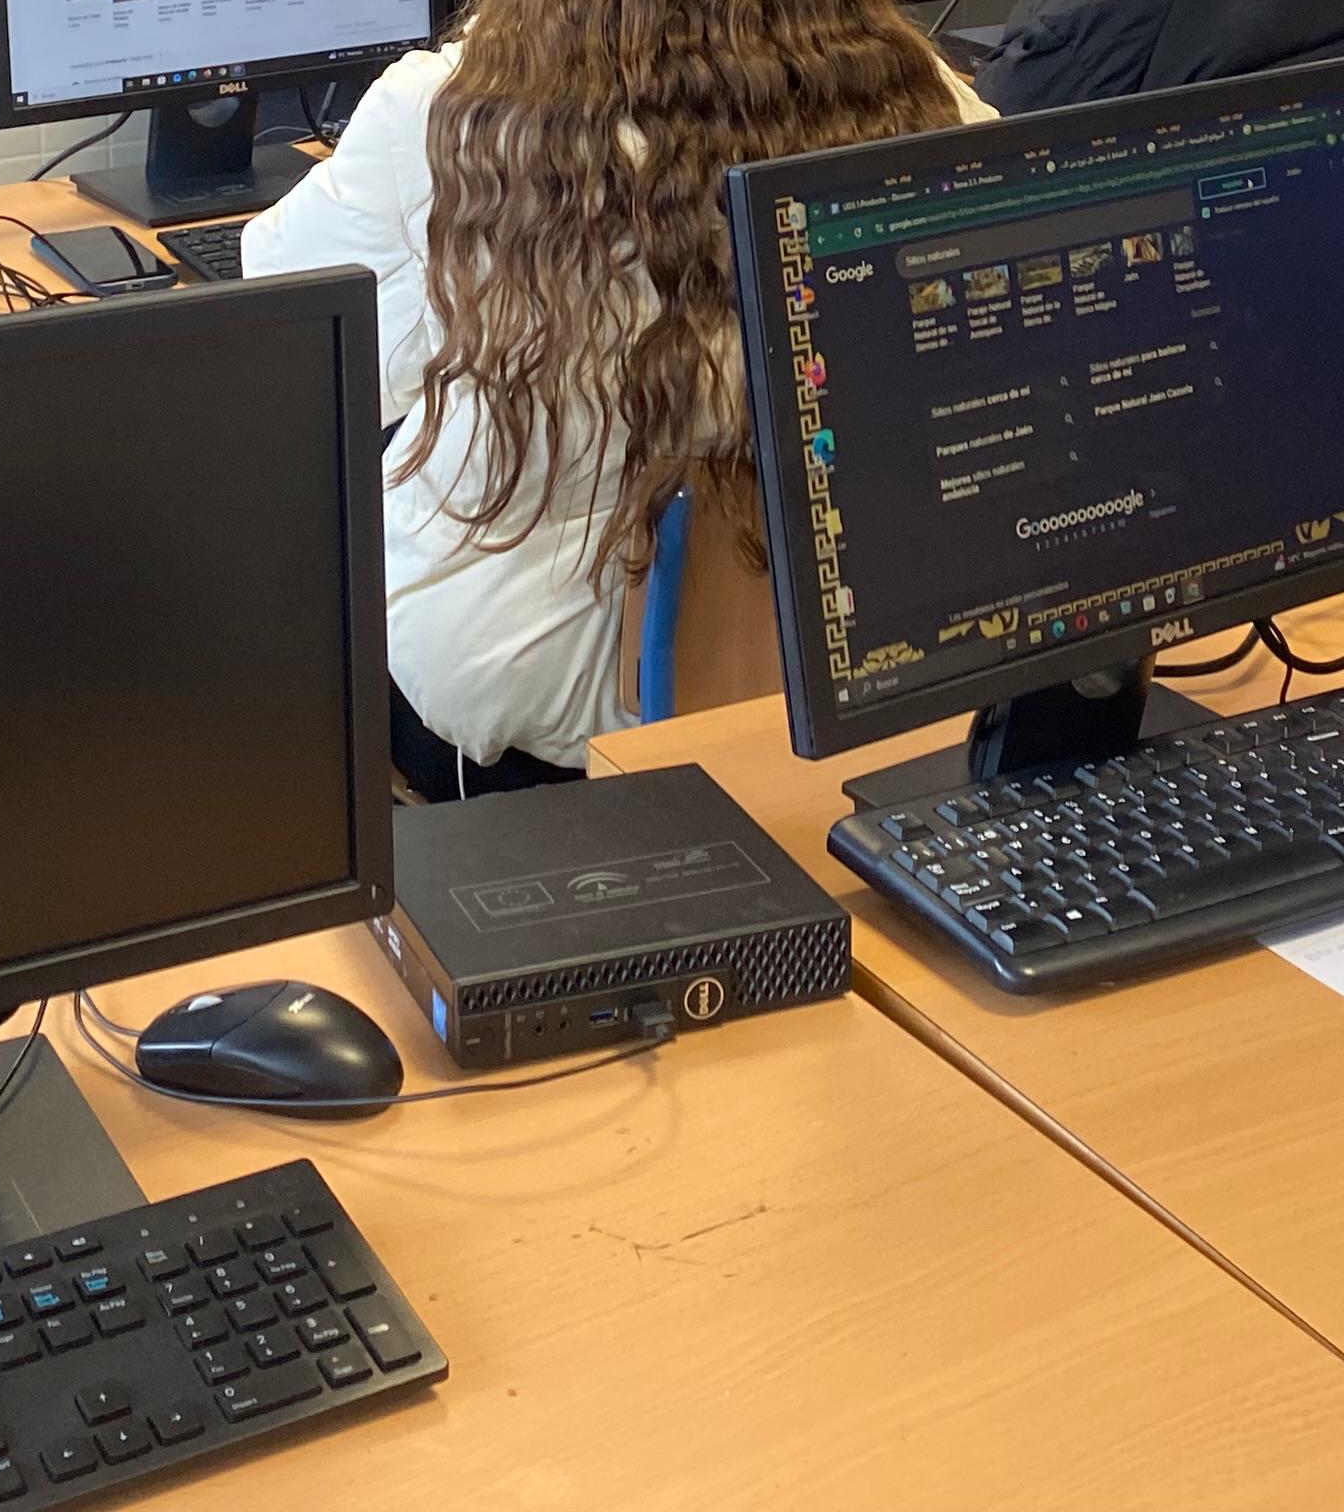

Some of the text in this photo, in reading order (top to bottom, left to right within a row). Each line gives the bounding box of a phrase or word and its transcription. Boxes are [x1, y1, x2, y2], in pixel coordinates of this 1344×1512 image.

[218, 80, 249, 96] DELL
[825, 260, 874, 284] Google
[1150, 616, 1196, 647] DELL
[699, 982, 710, 1015] DELL
[257, 1334, 267, 1345] 2
[224, 1387, 235, 1398] 0
